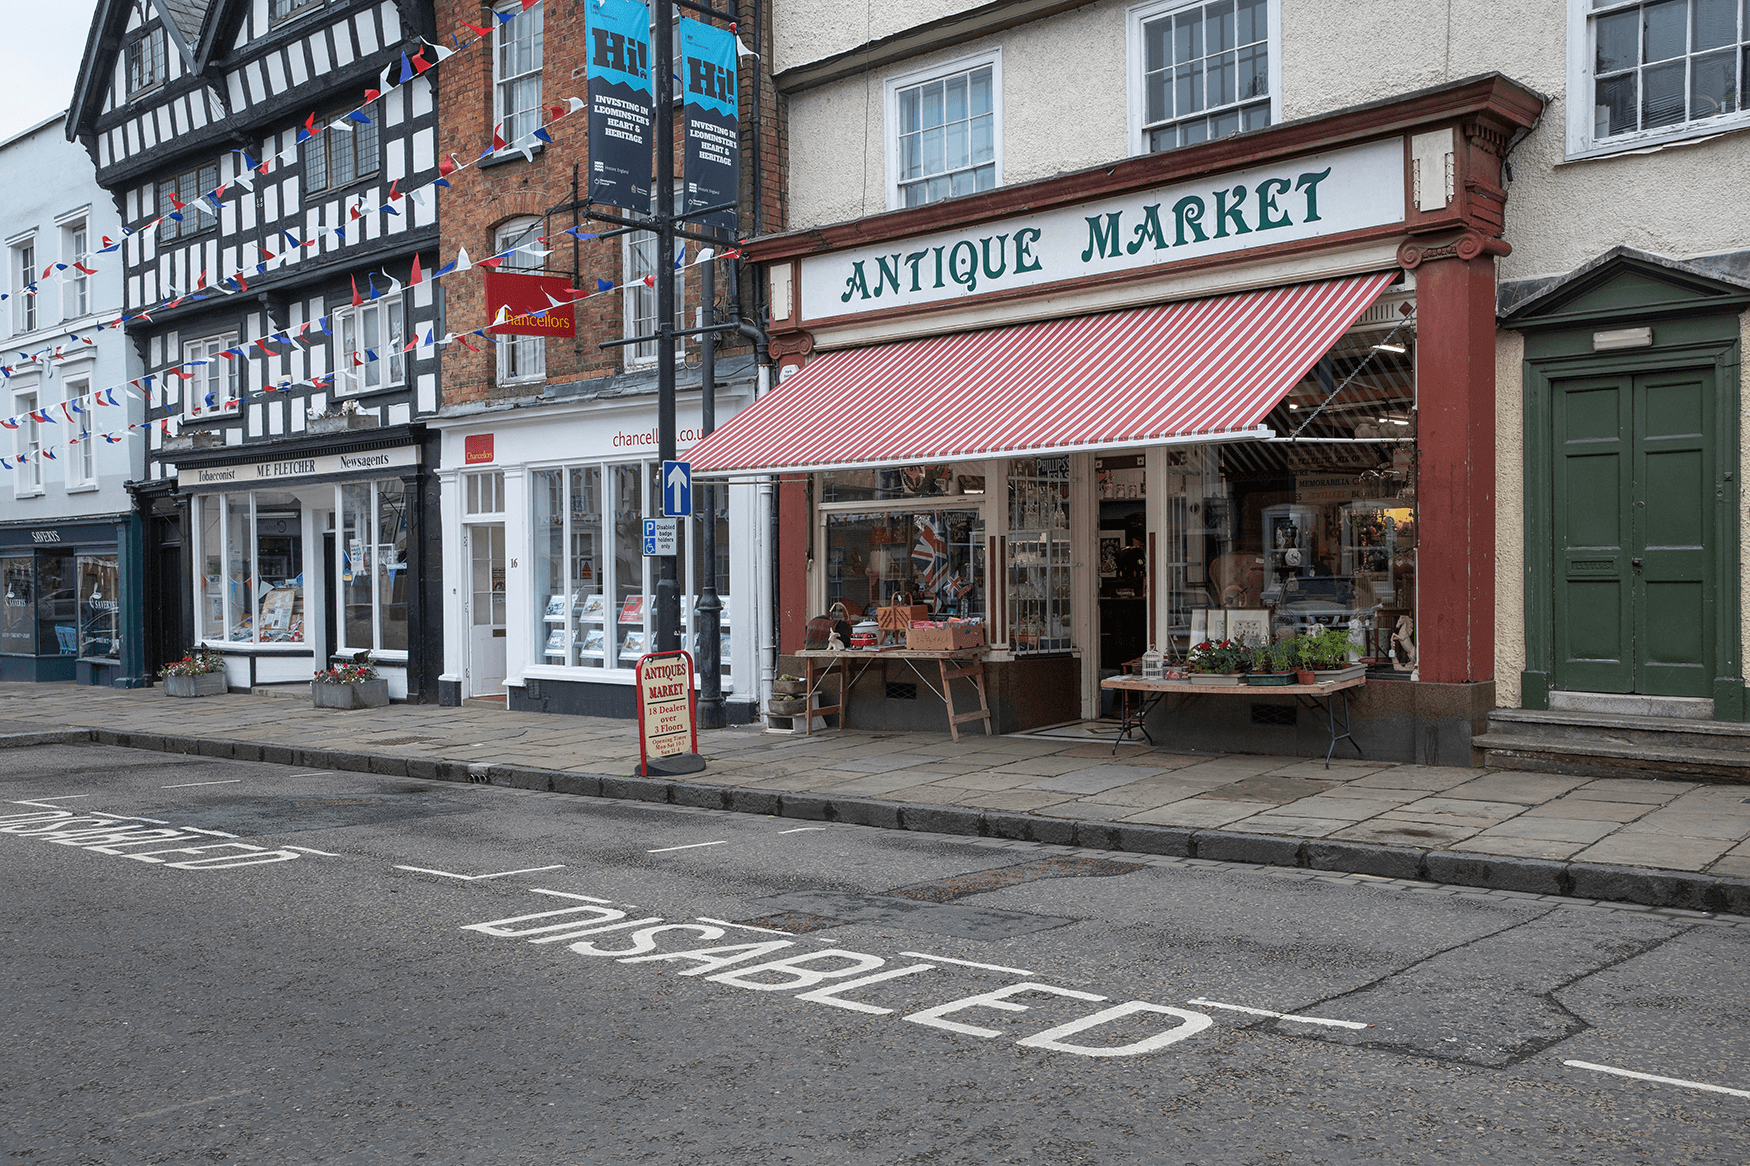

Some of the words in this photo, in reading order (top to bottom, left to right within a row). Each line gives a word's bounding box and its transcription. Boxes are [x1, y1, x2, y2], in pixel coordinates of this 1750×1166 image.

[592, 27, 647, 80] Hi!
[687, 56, 734, 105] Hi!
[595, 94, 640, 112] INVESTING
[640, 105, 649, 115] IN
[594, 105, 650, 126] LEOMINSTER'S
[607, 117, 634, 131] HEART
[635, 125, 641, 133] &
[691, 119, 729, 136] INVESTING
[729, 129, 736, 139] IN
[605, 127, 643, 144] HERITAGE
[690, 129, 738, 149] LEOMINSTER'S
[701, 141, 724, 153] HEART
[699, 151, 732, 166] HERITAGE
[840, 227, 1044, 303] ANTIQUE
[1081, 166, 1332, 263] MARKET
[613, 428, 703, 447] chancell.co.u
[274, 459, 315, 475] FLETCHER
[340, 454, 390, 469] Newsagents
[198, 468, 235, 482] Tobacconist
[1299, 478, 1350, 488] MEMORABILIA
[647, 522, 654, 535] P
[510, 558, 518, 568] 16
[644, 663, 686, 681] ANTIQUES
[649, 683, 684, 699] MARKET
[649, 706, 657, 716] 18
[659, 704, 686, 714] Dealers
[660, 715, 677, 724] over
[654, 725, 660, 734] 3
[661, 723, 683, 733] Floors
[652, 737, 672, 745] Opening
[459, 905, 1213, 1057] DISABLED
